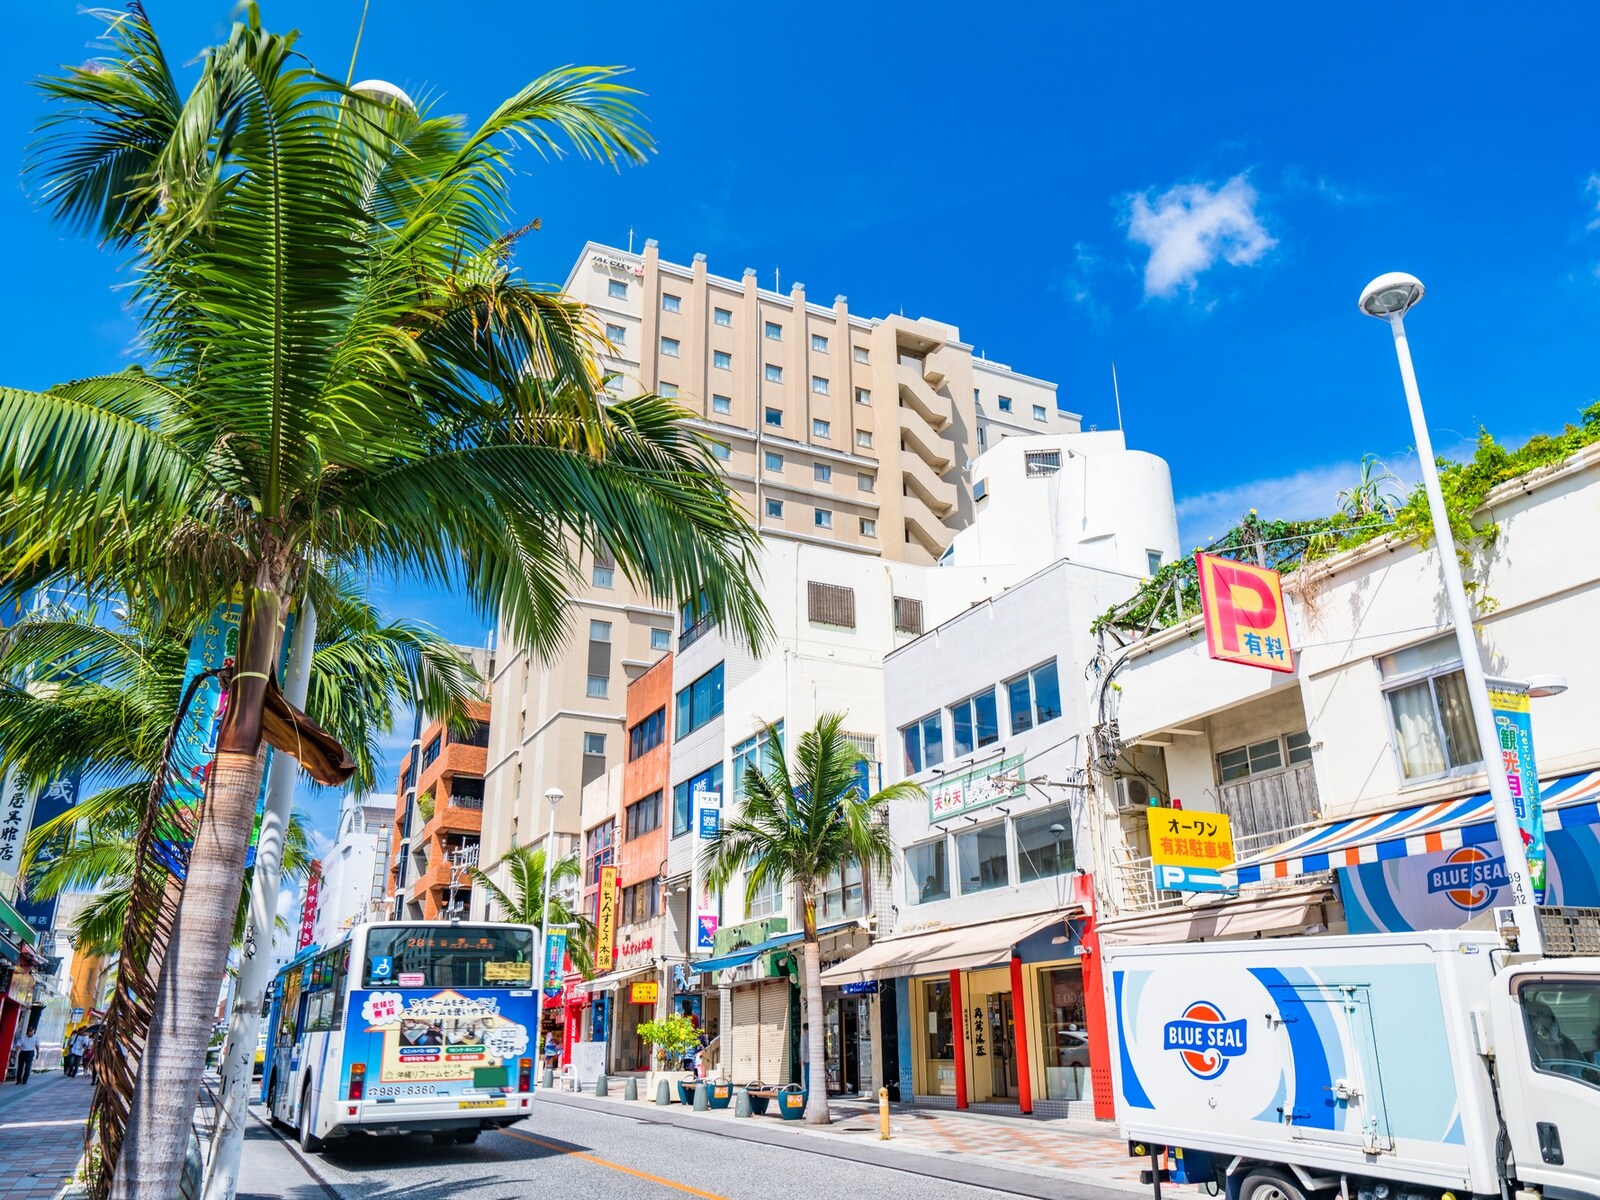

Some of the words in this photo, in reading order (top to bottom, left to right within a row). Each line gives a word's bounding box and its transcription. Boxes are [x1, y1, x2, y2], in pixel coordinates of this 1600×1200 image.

[592, 256, 608, 264] JAL
[609, 261, 632, 270] CITY
[1212, 563, 1277, 653] P
[1243, 632, 1285, 661] 有料
[934, 798, 943, 811] 天
[952, 790, 961, 806] 天
[1168, 818, 1218, 838] オーワン
[1160, 836, 1232, 862] 有料駐車場
[1162, 866, 1185, 888] P
[1433, 867, 1469, 888] BLUE
[407, 938, 425, 948] 28
[1169, 1026, 1203, 1046] BLUE
[1207, 1027, 1244, 1048] SEAL
[379, 1085, 436, 1096] 988-8360
